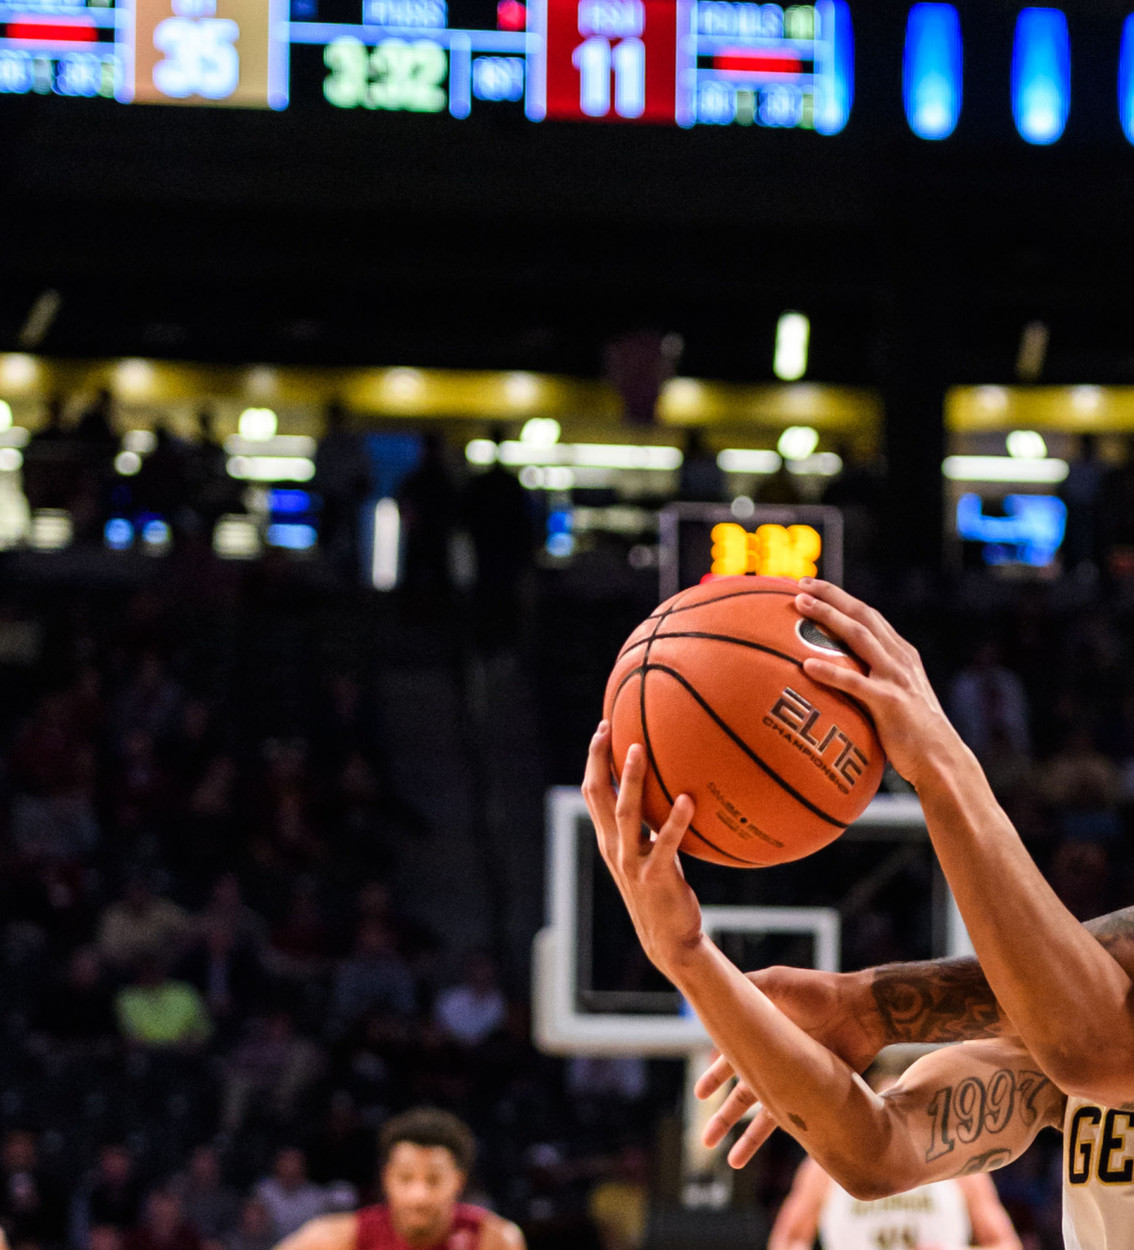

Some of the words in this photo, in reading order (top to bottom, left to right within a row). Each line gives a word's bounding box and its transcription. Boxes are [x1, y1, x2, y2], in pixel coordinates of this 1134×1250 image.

[153, 17, 239, 99] 35
[572, 36, 645, 118] 11
[769, 686, 869, 788] ELITE
[926, 1069, 1049, 1163] 1997
